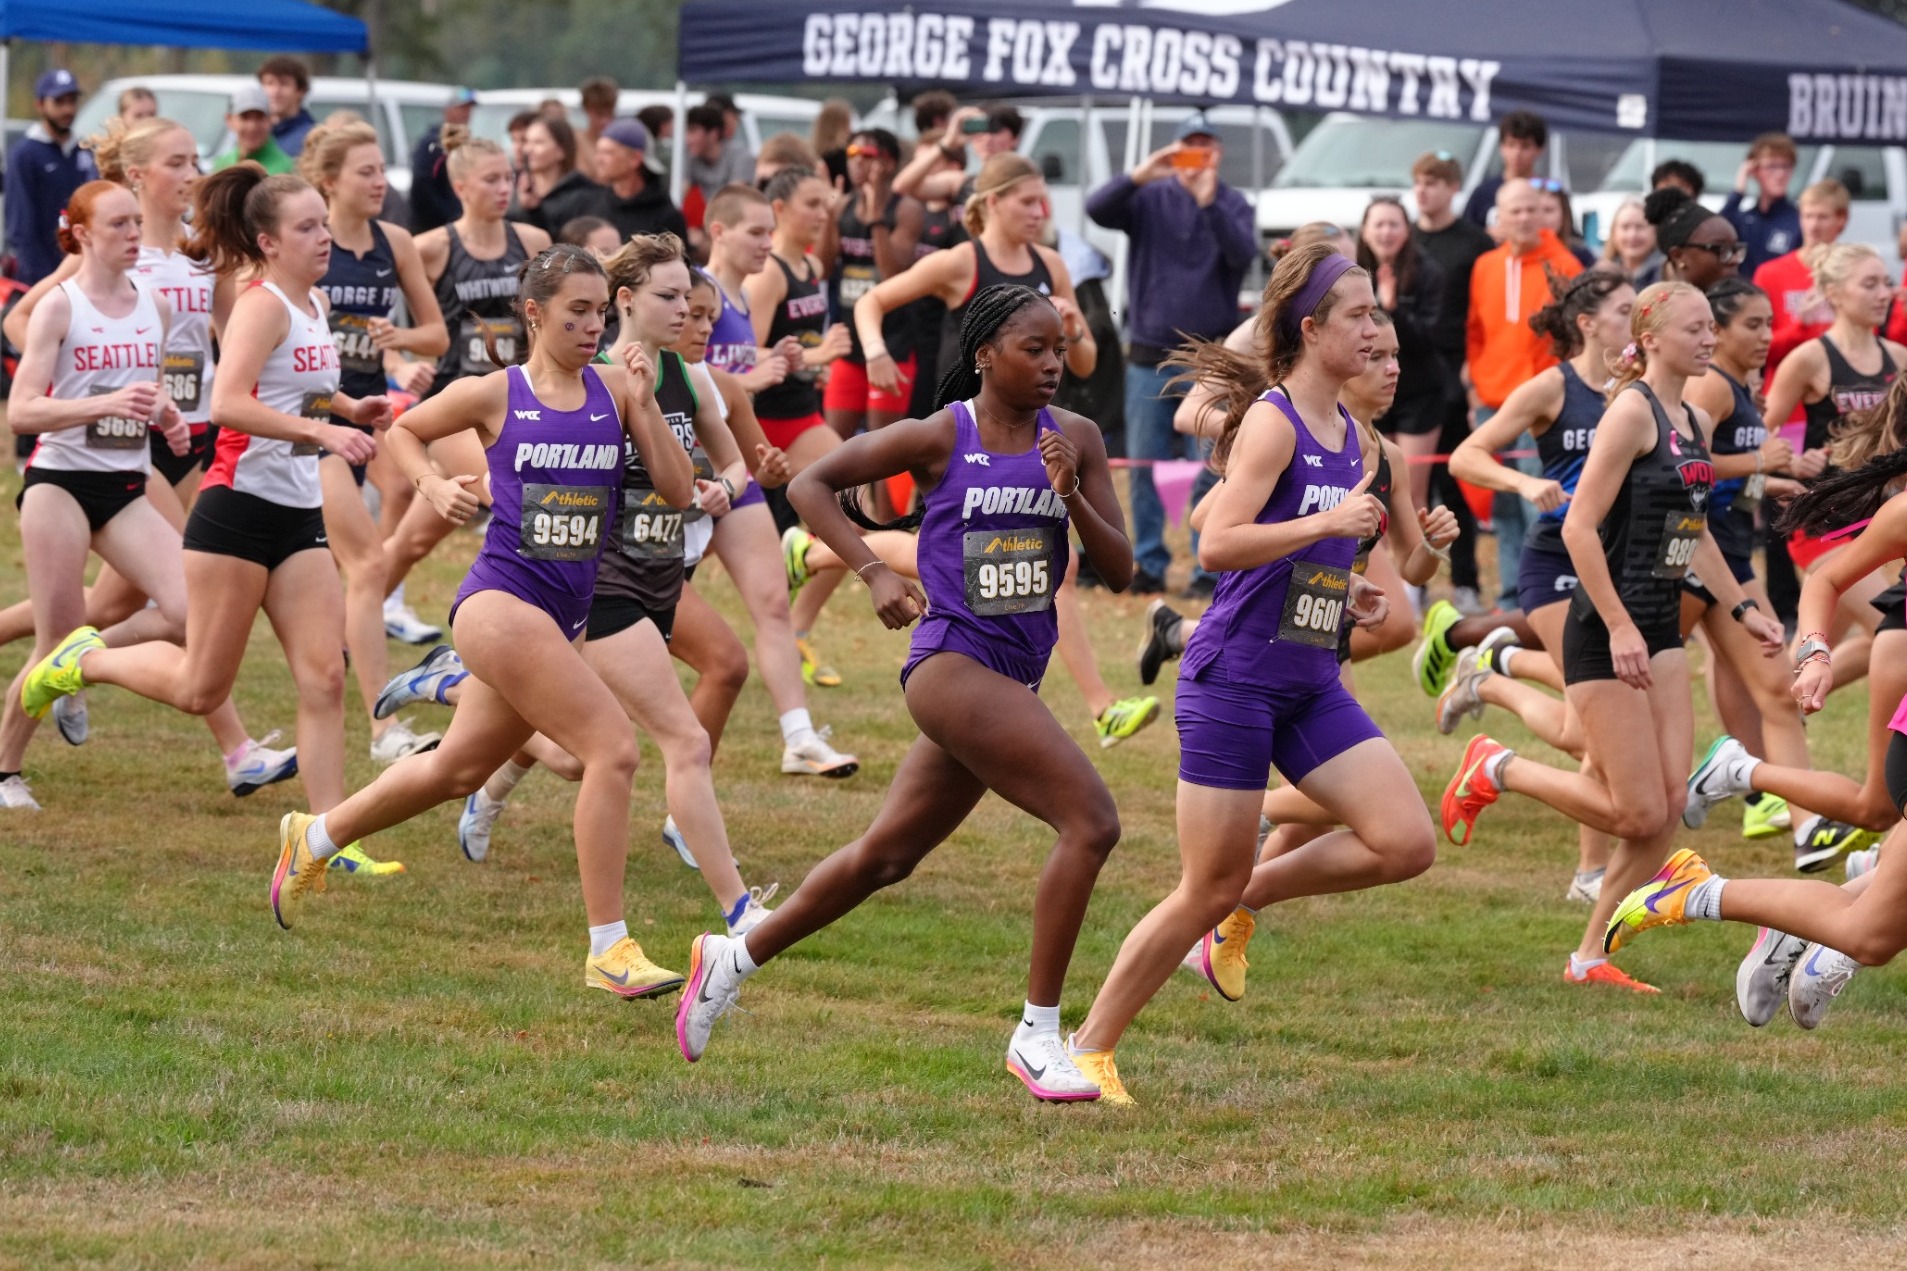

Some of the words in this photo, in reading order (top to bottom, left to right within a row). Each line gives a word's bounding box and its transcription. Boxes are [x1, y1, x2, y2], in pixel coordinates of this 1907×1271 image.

[803, 13, 974, 79] GEORGE
[983, 18, 1080, 86] FOX
[1091, 24, 1242, 98] CROSS
[1253, 38, 1500, 122] COUNTRY
[514, 443, 619, 472] PORTLAND
[540, 490, 599, 507] Athletic
[962, 486, 1068, 520] PORTLAN
[533, 513, 599, 546] 9594
[633, 513, 682, 543] 6477
[984, 535, 1043, 554] Athletic
[979, 559, 1049, 599] 9595
[1308, 571, 1347, 591] Athletic
